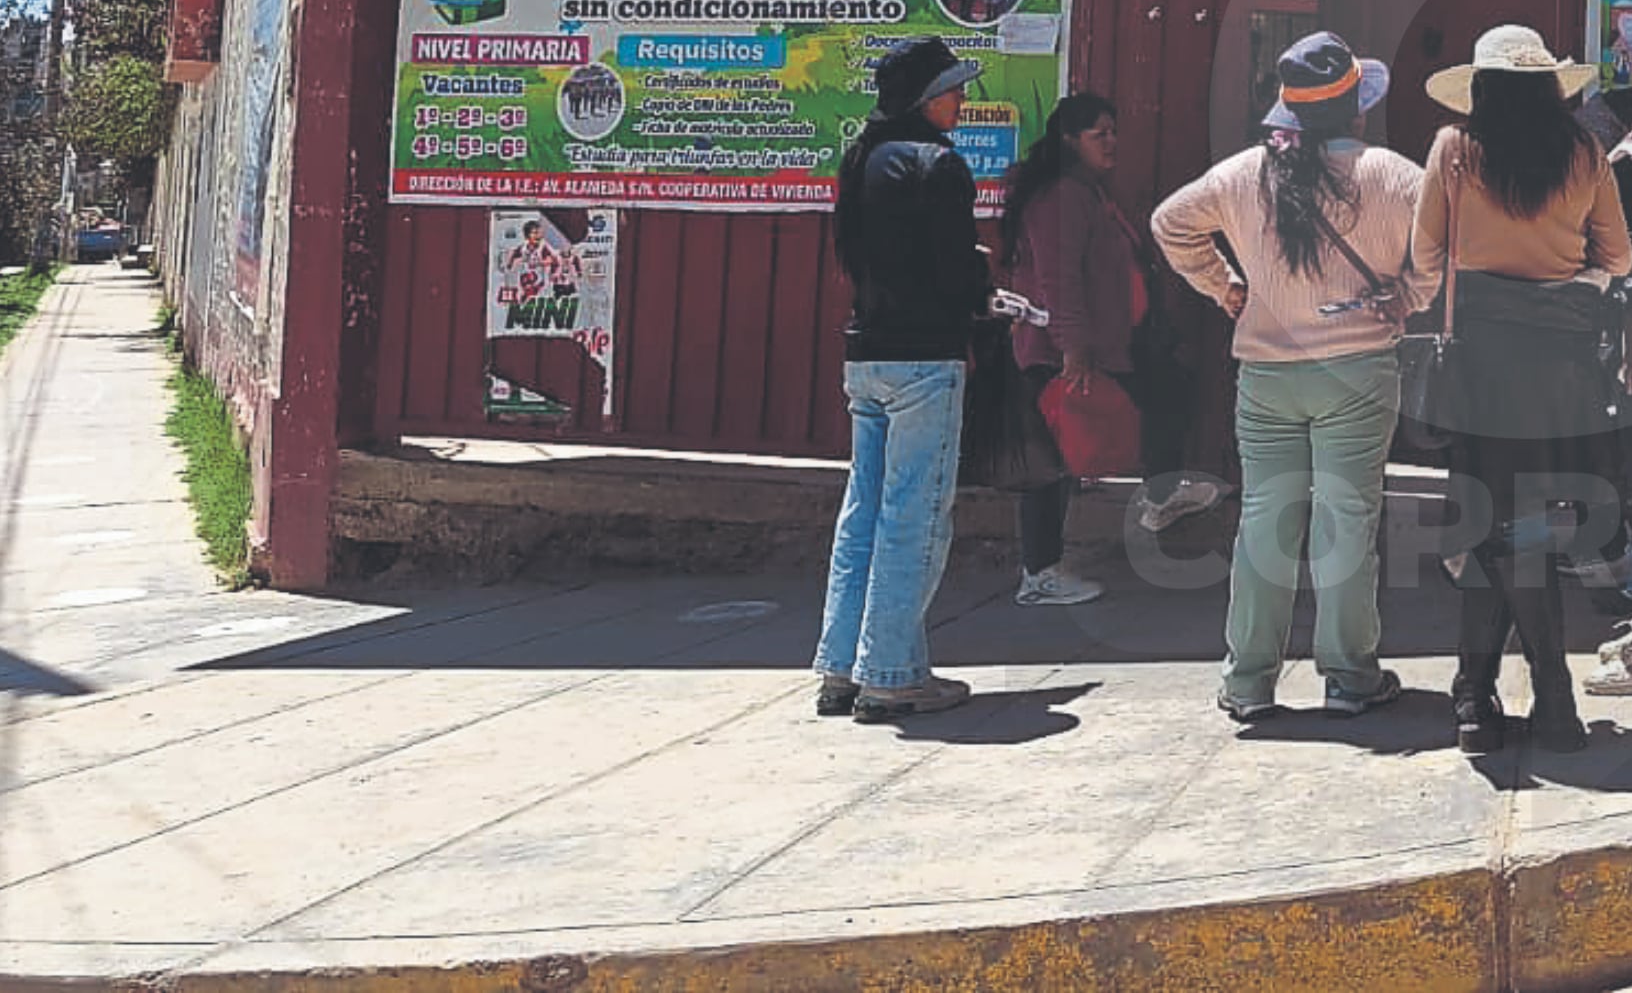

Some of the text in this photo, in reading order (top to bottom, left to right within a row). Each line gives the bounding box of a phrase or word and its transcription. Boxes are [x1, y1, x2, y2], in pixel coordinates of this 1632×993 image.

[418, 38, 581, 61] NIVEL PRIMARIA
[638, 39, 764, 63] Requisitos
[422, 73, 524, 95] Vacantes
[477, 176, 493, 191] DE
[498, 177, 513, 192] LA
[564, 179, 624, 196] ALAMEDA
[658, 181, 746, 199] COOPERATIVA
[750, 183, 767, 198] DE
[772, 183, 833, 200] VIVIENDA
[506, 296, 580, 329] MINI
